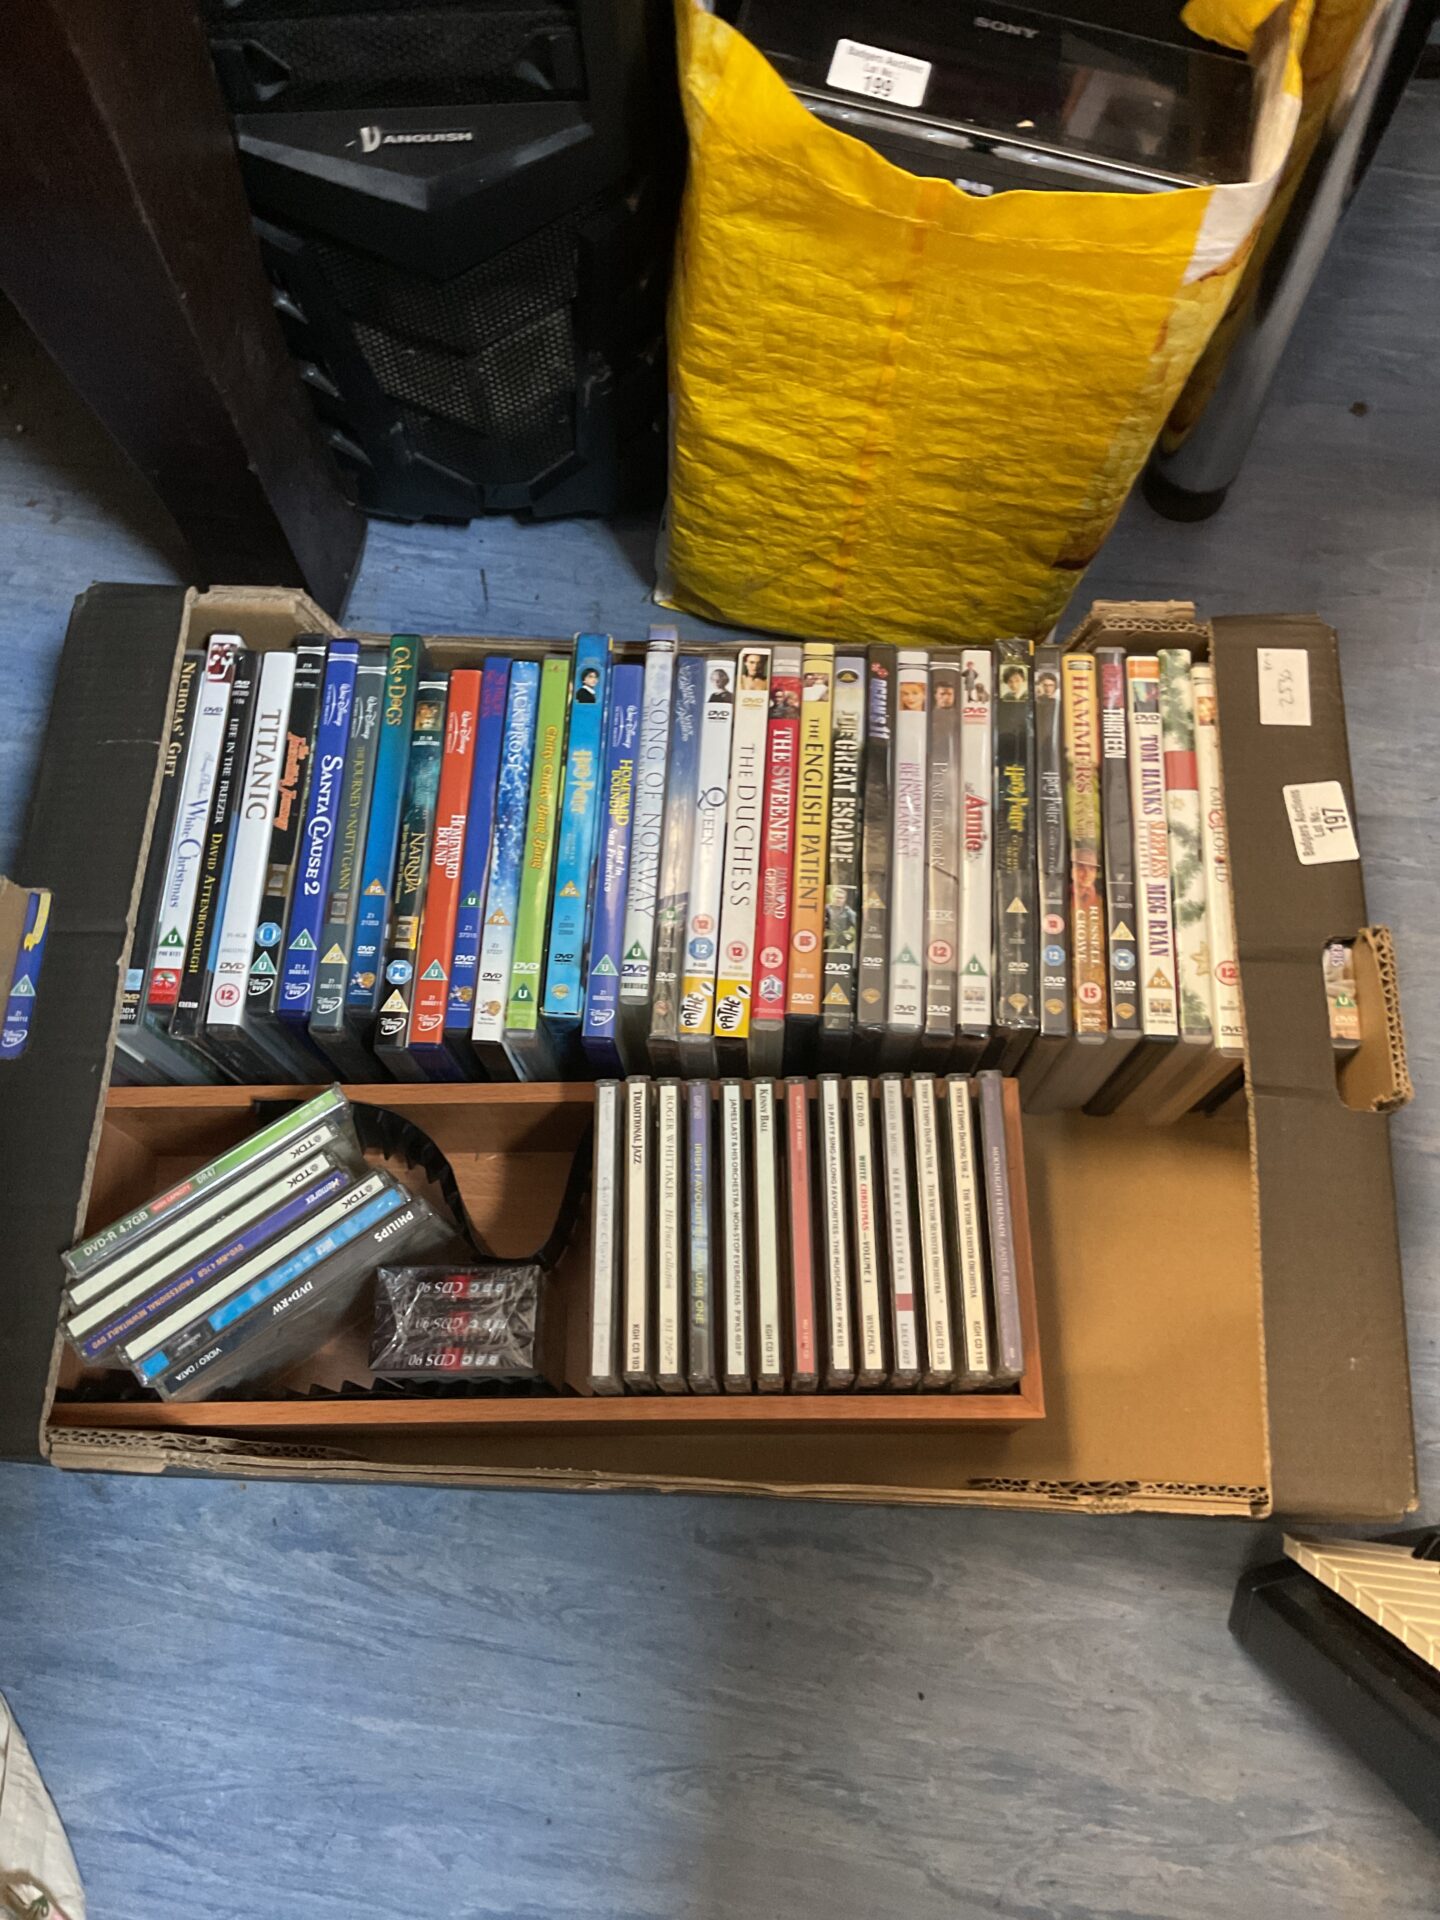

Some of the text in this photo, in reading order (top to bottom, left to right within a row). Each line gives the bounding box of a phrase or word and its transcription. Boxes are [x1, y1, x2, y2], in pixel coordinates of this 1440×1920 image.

[973, 16, 1039, 39] SONY
[864, 75, 895, 97] 199
[360, 125, 473, 152] VANQUISH
[164, 662, 197, 778] NICHOLAS' GIFT
[506, 680, 533, 770] JACK FROST
[869, 725, 891, 740] 11
[1072, 675, 1092, 794] HAMMERS
[1102, 708, 1127, 759] THIRTEEN
[246, 710, 282, 821] TITANIC
[1140, 735, 1159, 763] TOM
[530, 726, 558, 870] Chitty Chitty Bang Bang
[615, 759, 634, 825] HOMEWARD
[767, 727, 793, 854] THE SWEENEY
[829, 739, 858, 864] GREAT ESCAPE
[931, 762, 949, 805] PEARL
[1141, 768, 1164, 816] HANKS
[303, 755, 343, 896] SANTA CLAUSE 2
[338, 760, 365, 891] JOURNEY NATTY GANN
[633, 698, 669, 918] SONG OF NORWAY
[697, 786, 728, 846] QUEEN
[731, 744, 759, 907] THE DUCHESS
[798, 718, 824, 913] THE ENGLISH PATIENT
[964, 795, 988, 852] Annie
[1321, 807, 1349, 833] 197
[169, 801, 209, 909] White Christmas
[188, 718, 241, 974] LIFE IN THE FREEZER DAVID ATTENBOROUGH
[404, 832, 428, 895] NARNIA
[433, 826, 453, 866] BOUND
[443, 815, 467, 879] HOMEWARD
[602, 828, 618, 893] San Francisco
[614, 845, 627, 876] Lost in
[1148, 820, 1169, 878] SLEEPLESS
[1076, 909, 1087, 963] CROWE
[1088, 905, 1100, 968] RUSSELL
[1145, 883, 1170, 957] MEG RYAN
[512, 961, 540, 973] DVD
[621, 963, 650, 972] DVD
[694, 943, 708, 955] 12
[825, 963, 851, 972] DVD
[220, 987, 234, 1000] 12
[729, 1099, 738, 1121] JAMES
[887, 1085, 898, 1120] LEGENDS
[921, 1083, 930, 1104] STRICT
[632, 1090, 643, 1143] TRADITIONAL
[665, 1095, 675, 1131] ROGER
[829, 1111, 837, 1135] PARTY
[922, 1105, 931, 1127] TEMPO
[290, 1140, 316, 1159] TDK
[631, 1145, 643, 1165] JAZZ
[665, 1133, 675, 1198] WHITTAKER
[694, 1143, 703, 1172] IRISH
[287, 1168, 312, 1188] TDK
[731, 1162, 740, 1208] ORCHESTRA
[991, 1146, 1003, 1197] MOONLIGHT
[305, 1177, 340, 1205] Memorex
[341, 1190, 367, 1210] TDK
[927, 1184, 935, 1198] THE
[928, 1199, 937, 1221] VICTOR
[374, 1210, 414, 1243] PHILIPS
[760, 1088, 774, 1340] KENNY BALL KGH
[856, 1092, 877, 1355] LECD WHITE CHRISTMAS VOLUME WISEPACK
[955, 1087, 982, 1337] STRICT TEMPO DANCING THE VICTOR SILVESTER ORCHESTRA KGH
[996, 1198, 1007, 1237] SERENADE
[83, 1210, 149, 1256] DVD-R 4.7GB
[833, 1240, 841, 1255] THE
[930, 1222, 940, 1256] SILVESTER
[432, 1281, 463, 1294] CDS
[733, 1254, 742, 1305] EVERGREENS
[834, 1256, 843, 1312] MUSICMAKERS
[932, 1256, 942, 1294] ORCHESTRA
[147, 1277, 195, 1312] PROFESSIONAL
[272, 1281, 314, 1316] DVD+RW
[695, 1300, 704, 1325] ONE
[107, 1309, 148, 1340] REWRITABLE
[632, 1323, 641, 1340] KGH
[175, 1347, 222, 1382] VIDEO DATA
[407, 1353, 424, 1367] 90
[424, 1353, 456, 1367] CDS
